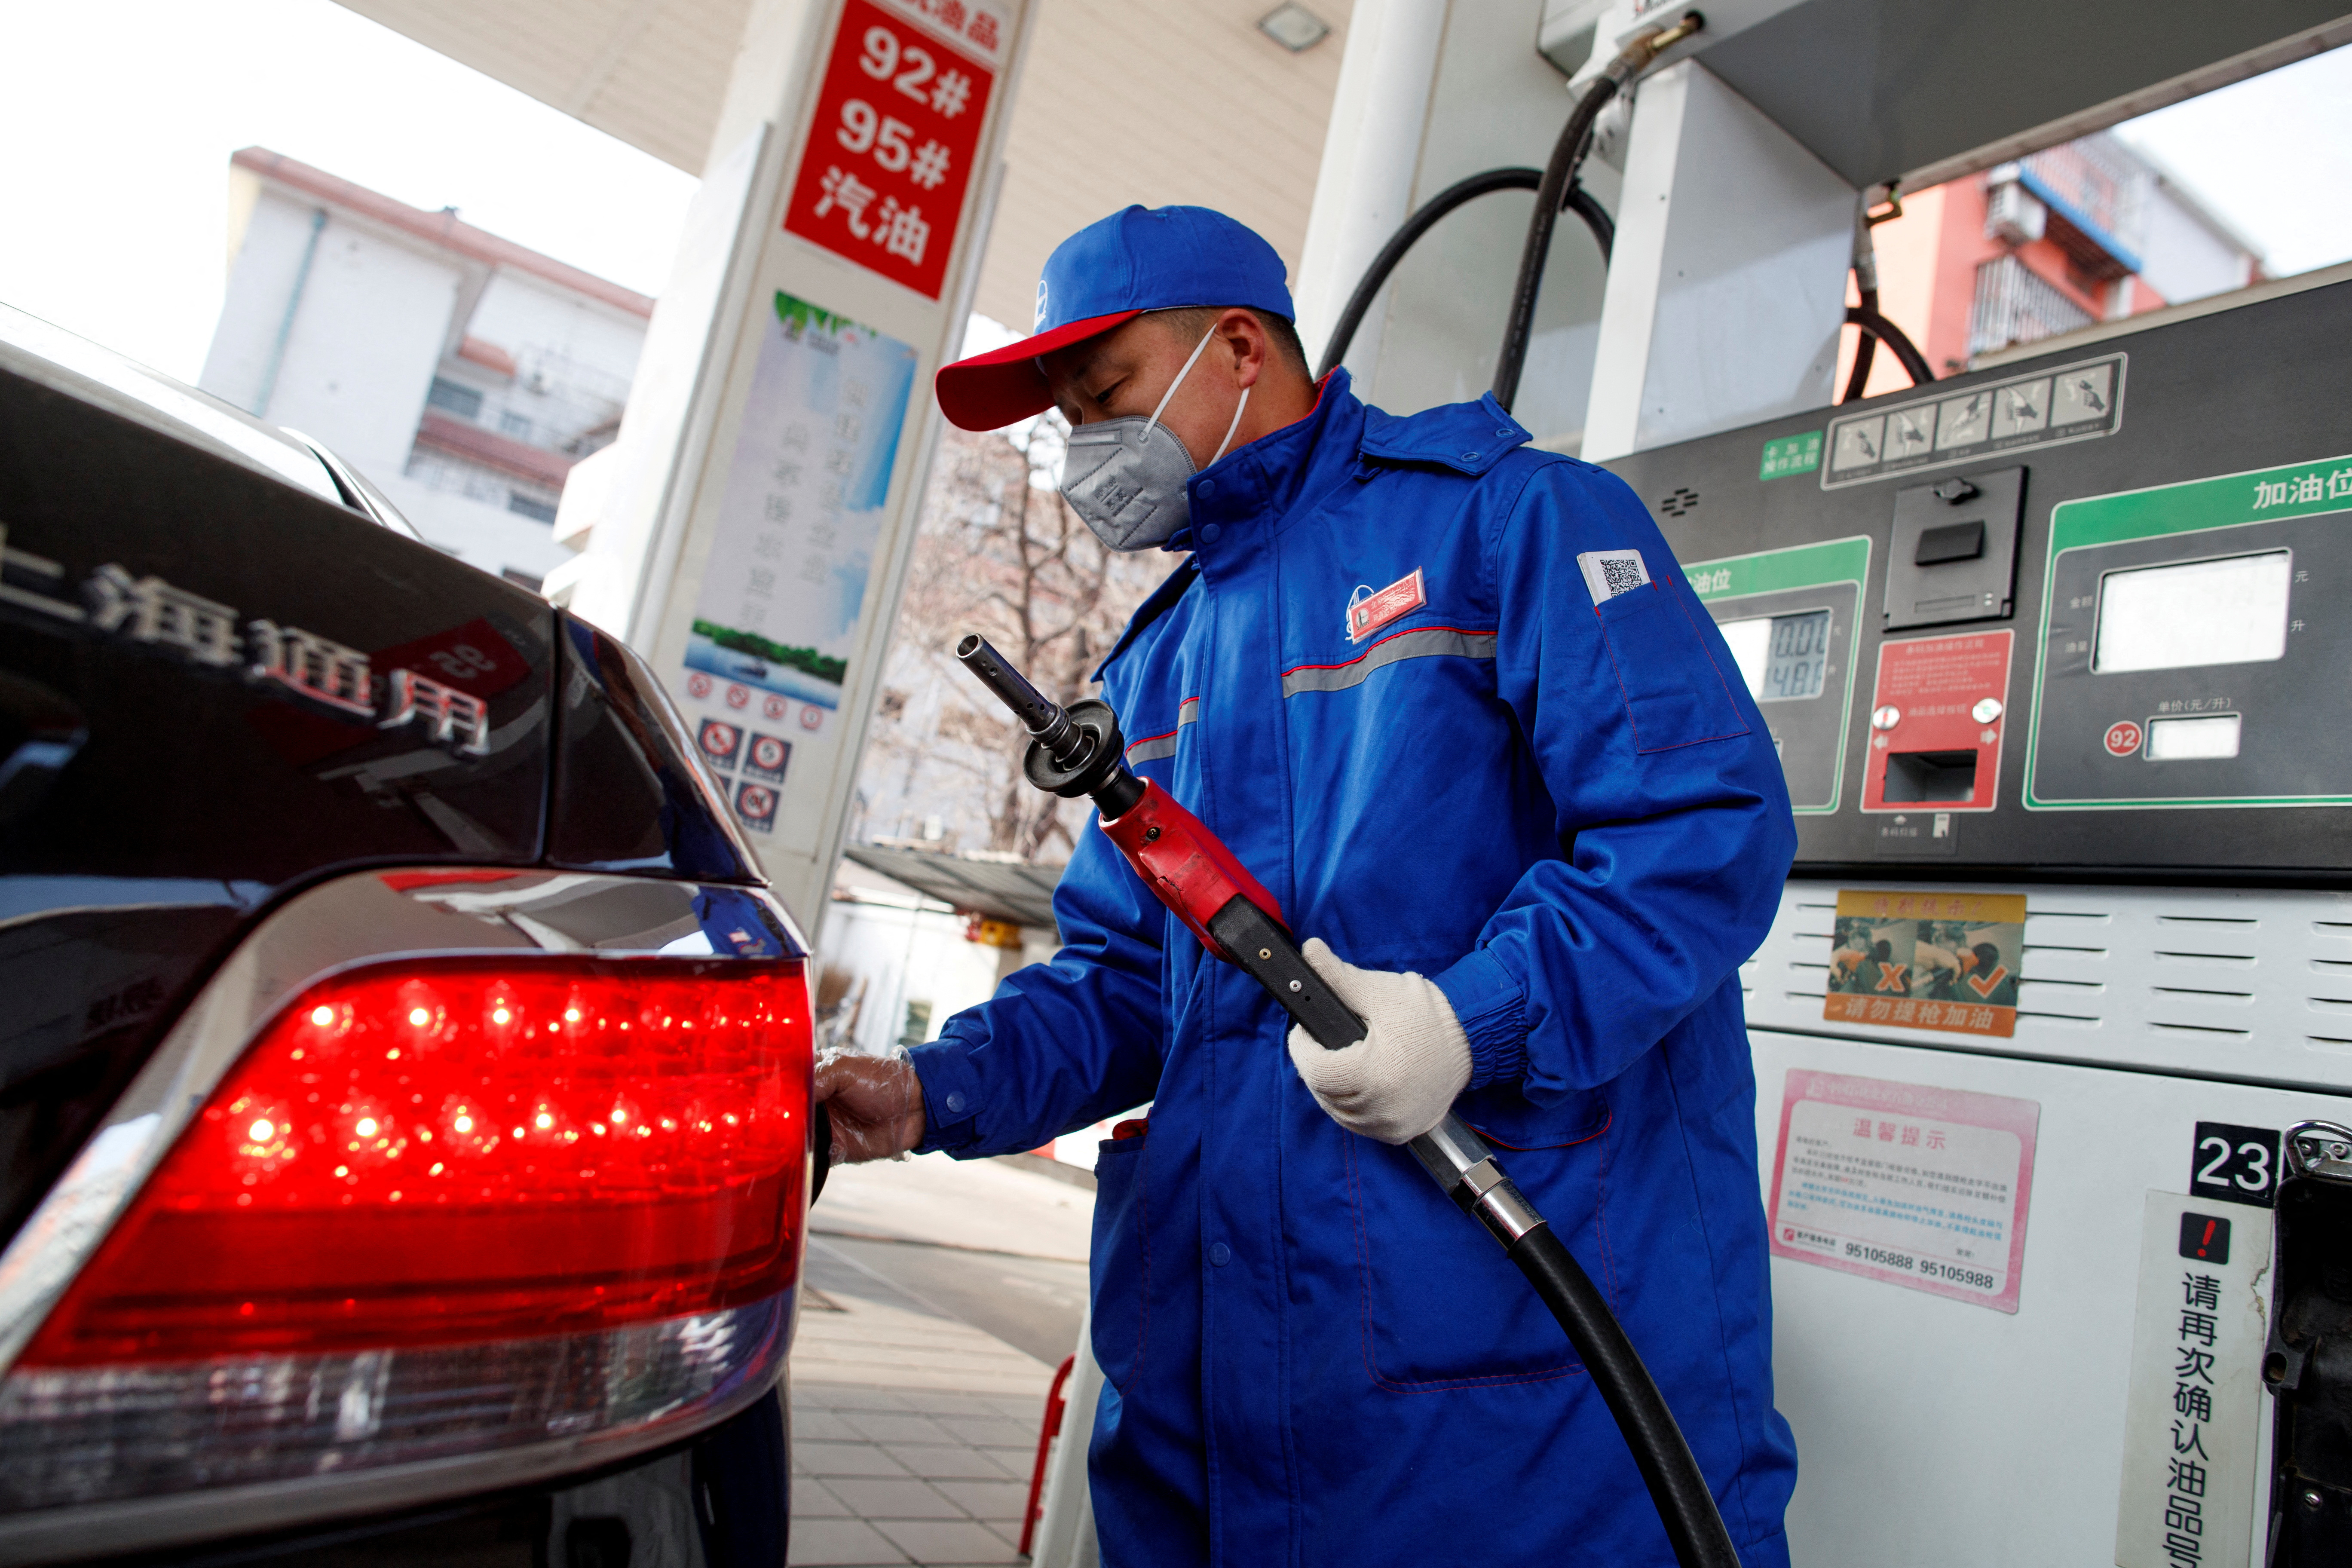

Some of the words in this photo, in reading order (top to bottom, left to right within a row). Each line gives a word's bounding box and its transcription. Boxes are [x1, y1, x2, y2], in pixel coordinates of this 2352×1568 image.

[858, 25, 972, 119] 92#
[836, 98, 951, 190] 95#
[812, 164, 931, 266] 汽油
[2253, 469, 2352, 510] 加油位
[1688, 568, 1731, 594] 油位
[2295, 570, 2309, 583] 元
[2291, 619, 2306, 633] 升
[2158, 697, 2233, 713] 单价(元/升)
[2109, 729, 2136, 748] 92
[1845, 997, 1994, 1029] 请勿提枪加油
[1853, 1117, 1947, 1150] 温馨提示
[2196, 1136, 2271, 1192] 23
[1845, 1242, 1913, 1270] 95105888
[1920, 1260, 1994, 1289] 95105988
[2162, 1272, 2221, 1568] 请再次确认油品号
